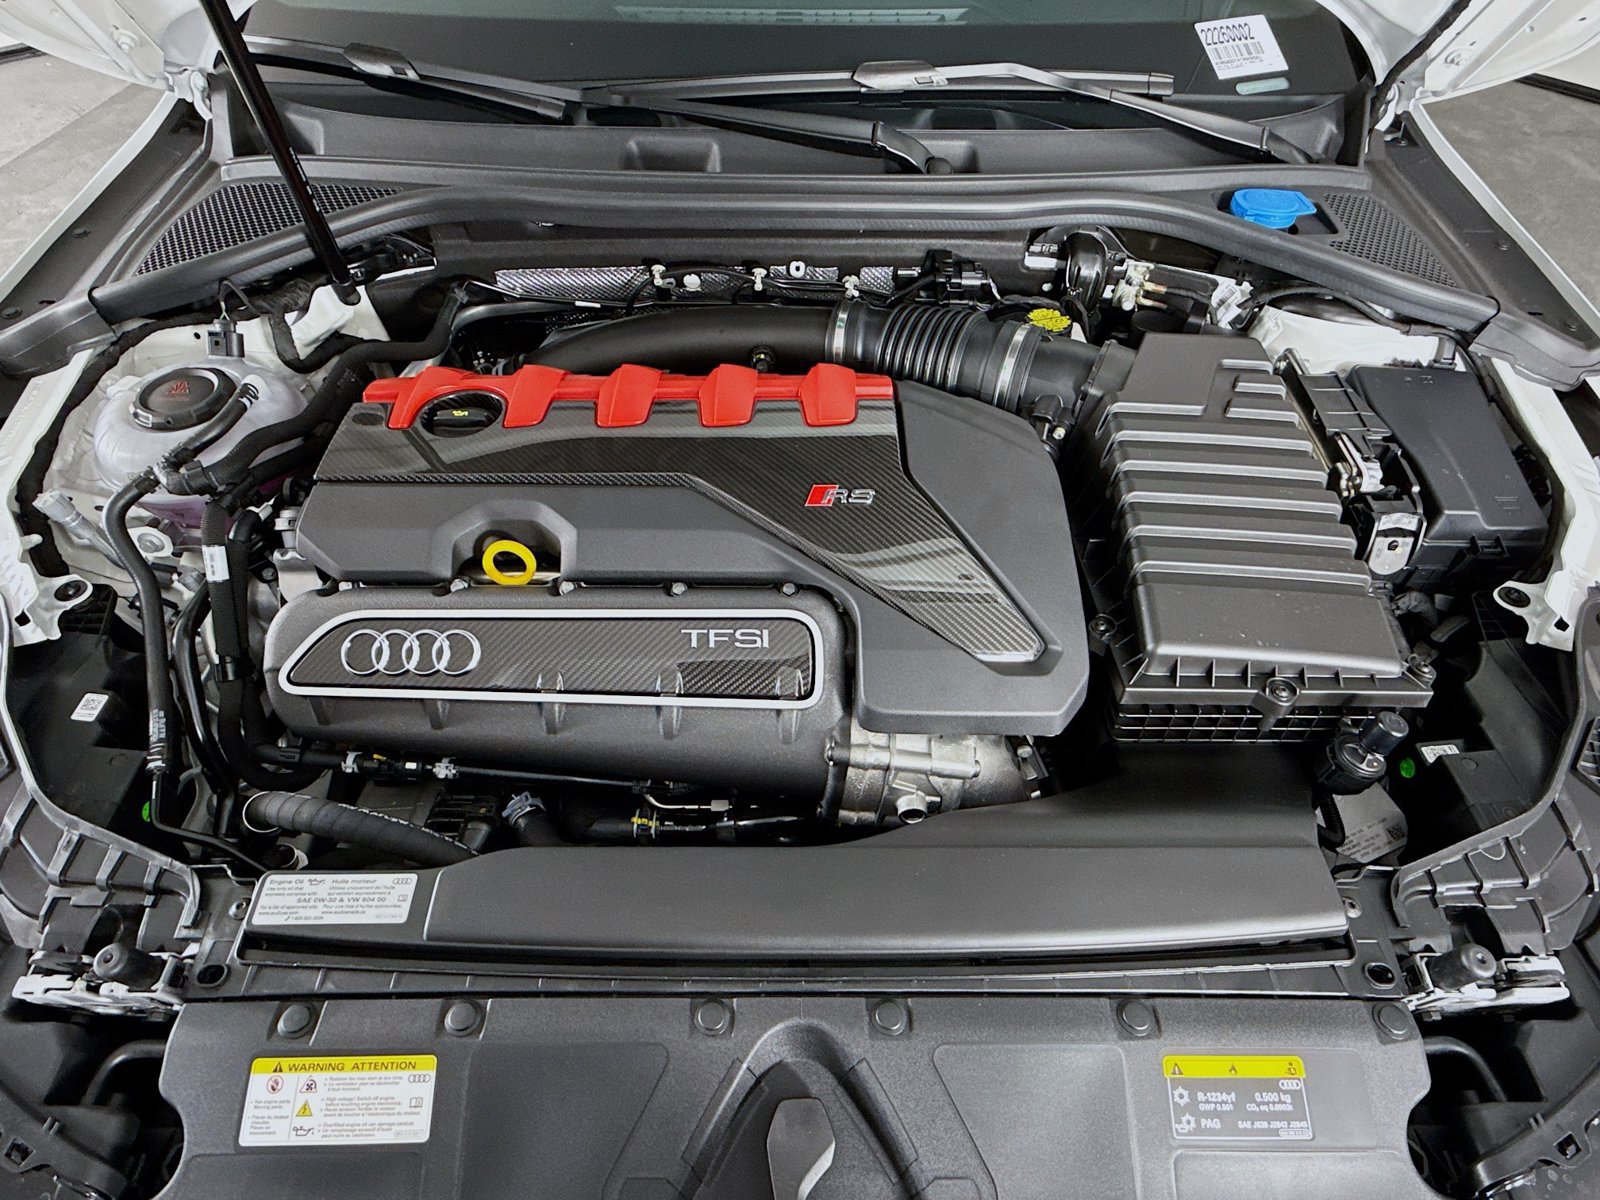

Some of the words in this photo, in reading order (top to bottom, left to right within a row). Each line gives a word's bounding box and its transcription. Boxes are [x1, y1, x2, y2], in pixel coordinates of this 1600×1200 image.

[1200, 22, 1255, 46] 22260002
[818, 487, 876, 505] RS
[680, 628, 770, 648] TFSI
[288, 1062, 345, 1072] WARNING
[350, 1061, 417, 1071] ATTENTION
[1197, 1092, 1236, 1102] R-1234yf
[1254, 1092, 1279, 1102] 0.500
[1280, 1092, 1292, 1103] kg
[1200, 1118, 1221, 1129] PAG
[1238, 1120, 1252, 1129] SAE
